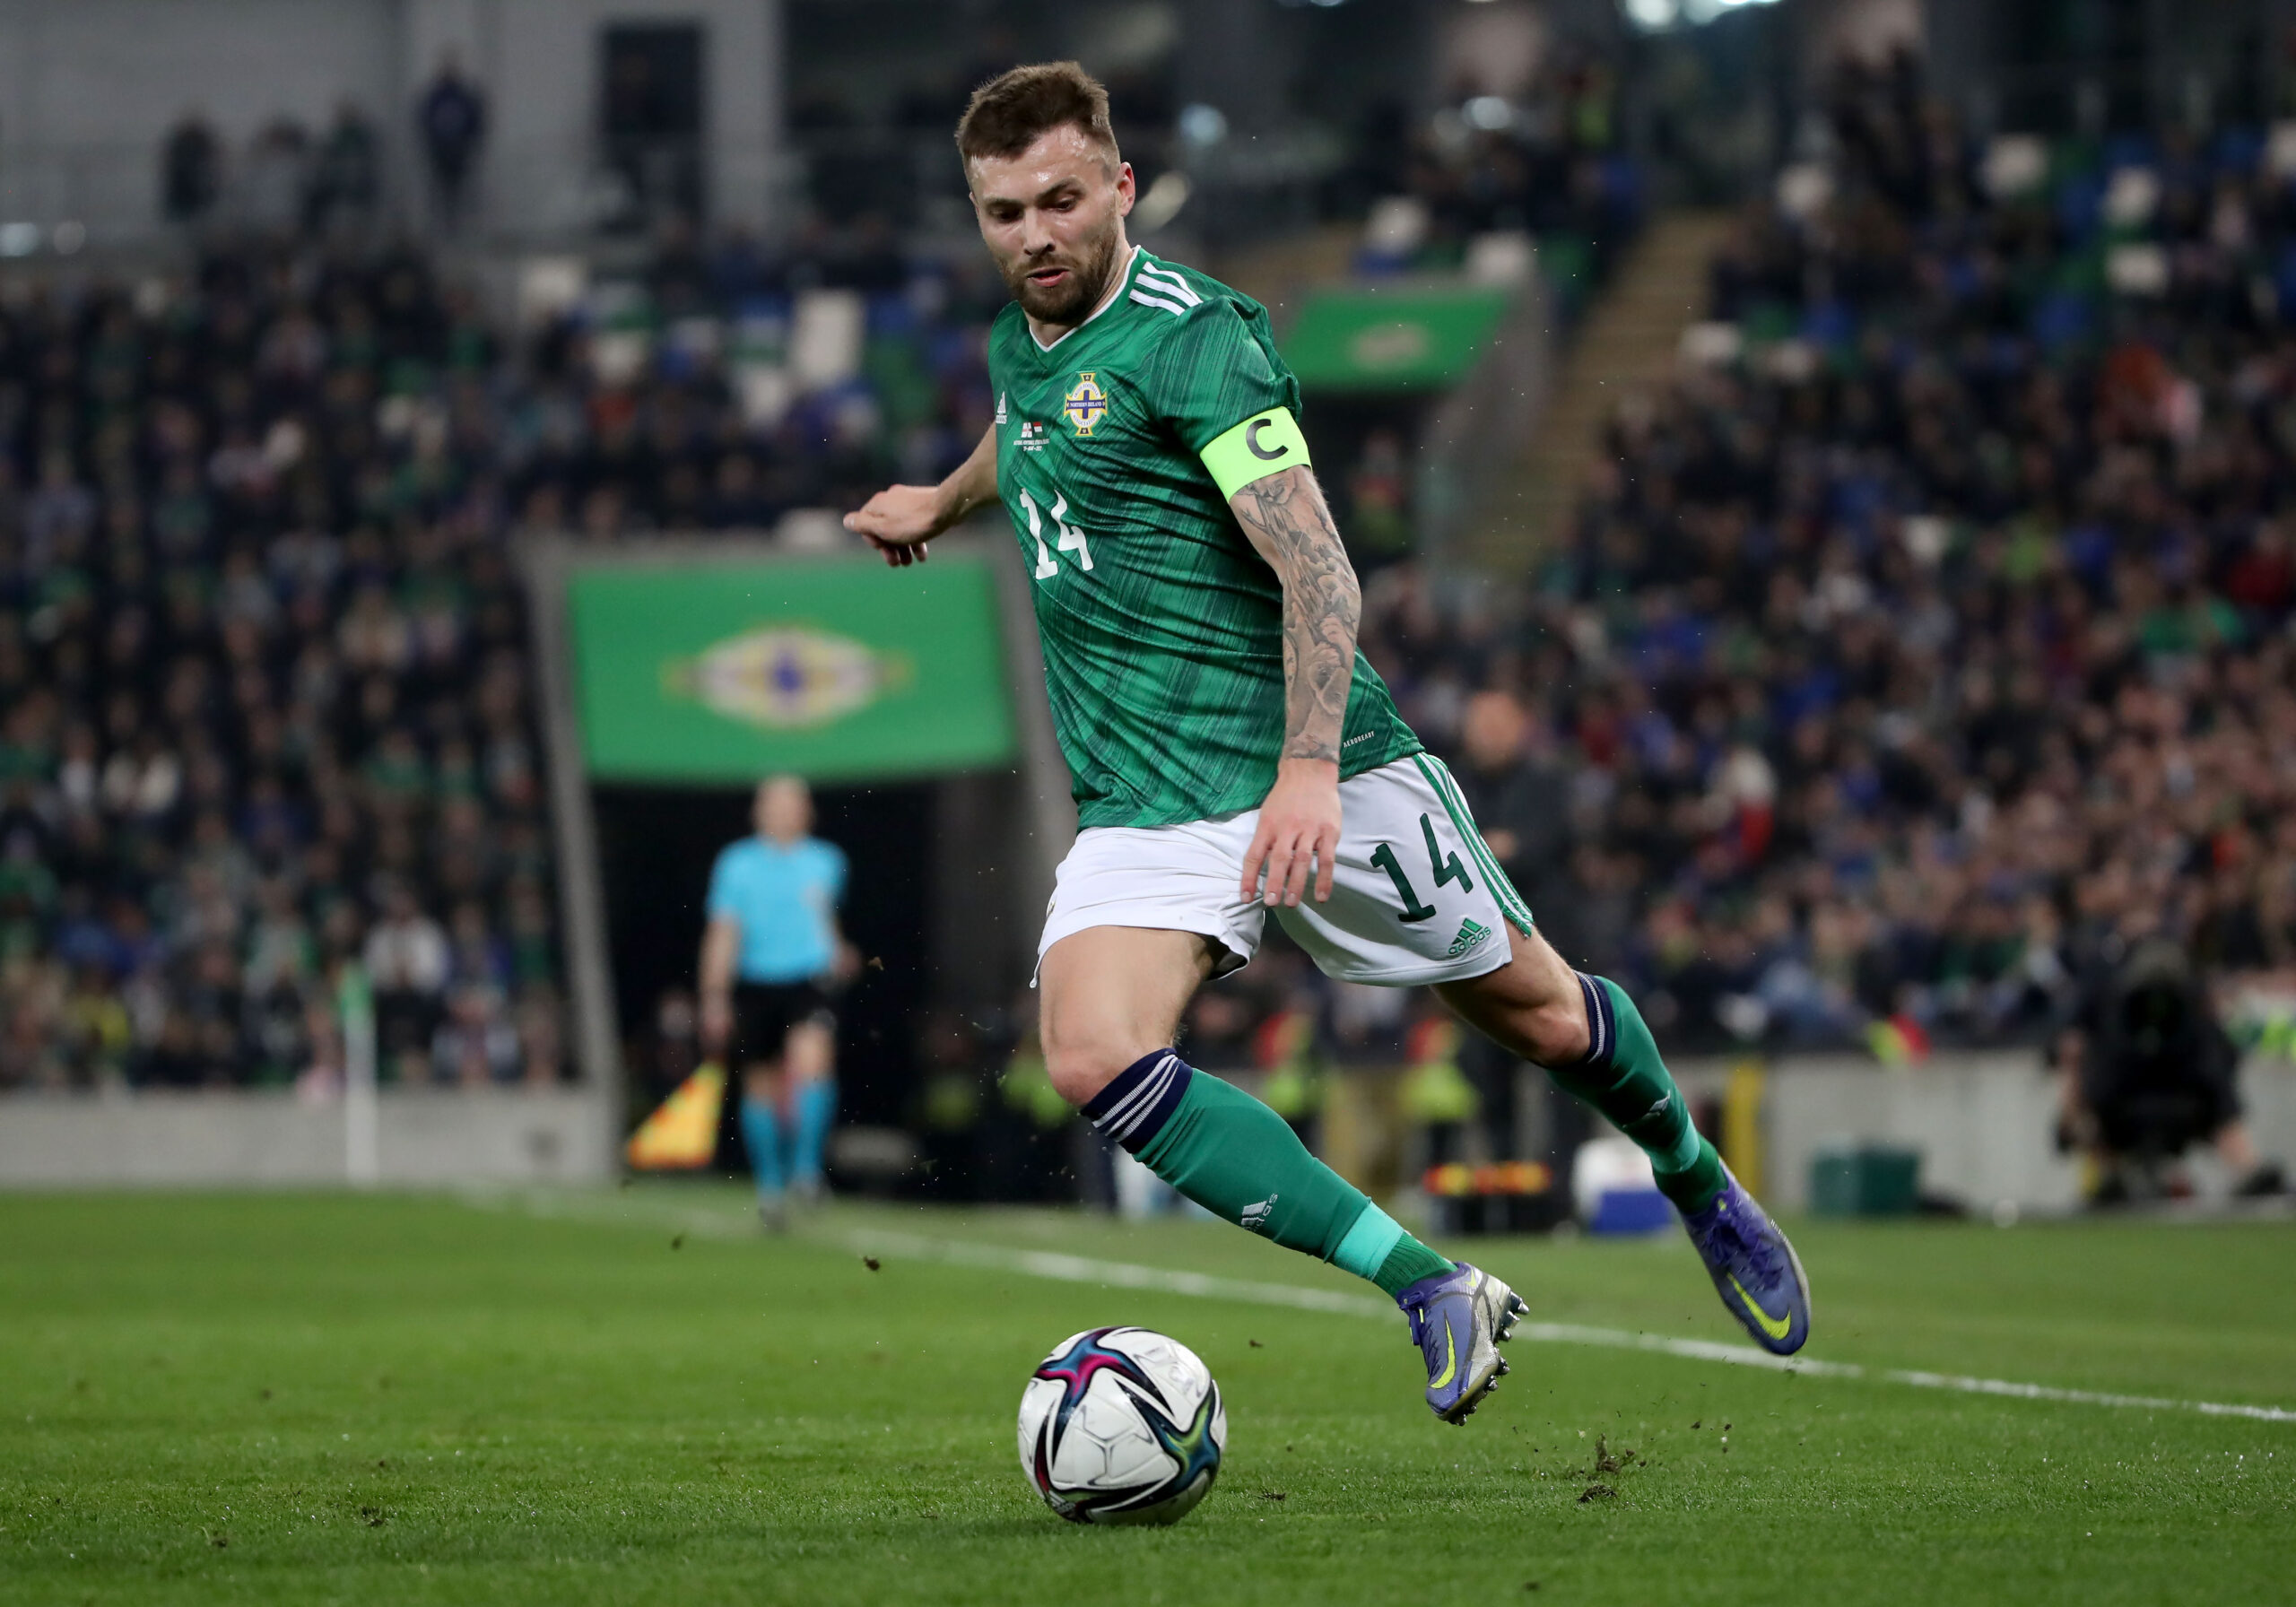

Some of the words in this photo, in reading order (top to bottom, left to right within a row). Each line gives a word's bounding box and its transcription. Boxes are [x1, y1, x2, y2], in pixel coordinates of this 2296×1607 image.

[1246, 418, 1289, 460] C
[1019, 488, 1094, 580] 14
[1343, 730, 1375, 748] AEROREADY
[1370, 812, 1474, 923] 14
[1448, 925, 1492, 955] adidas
